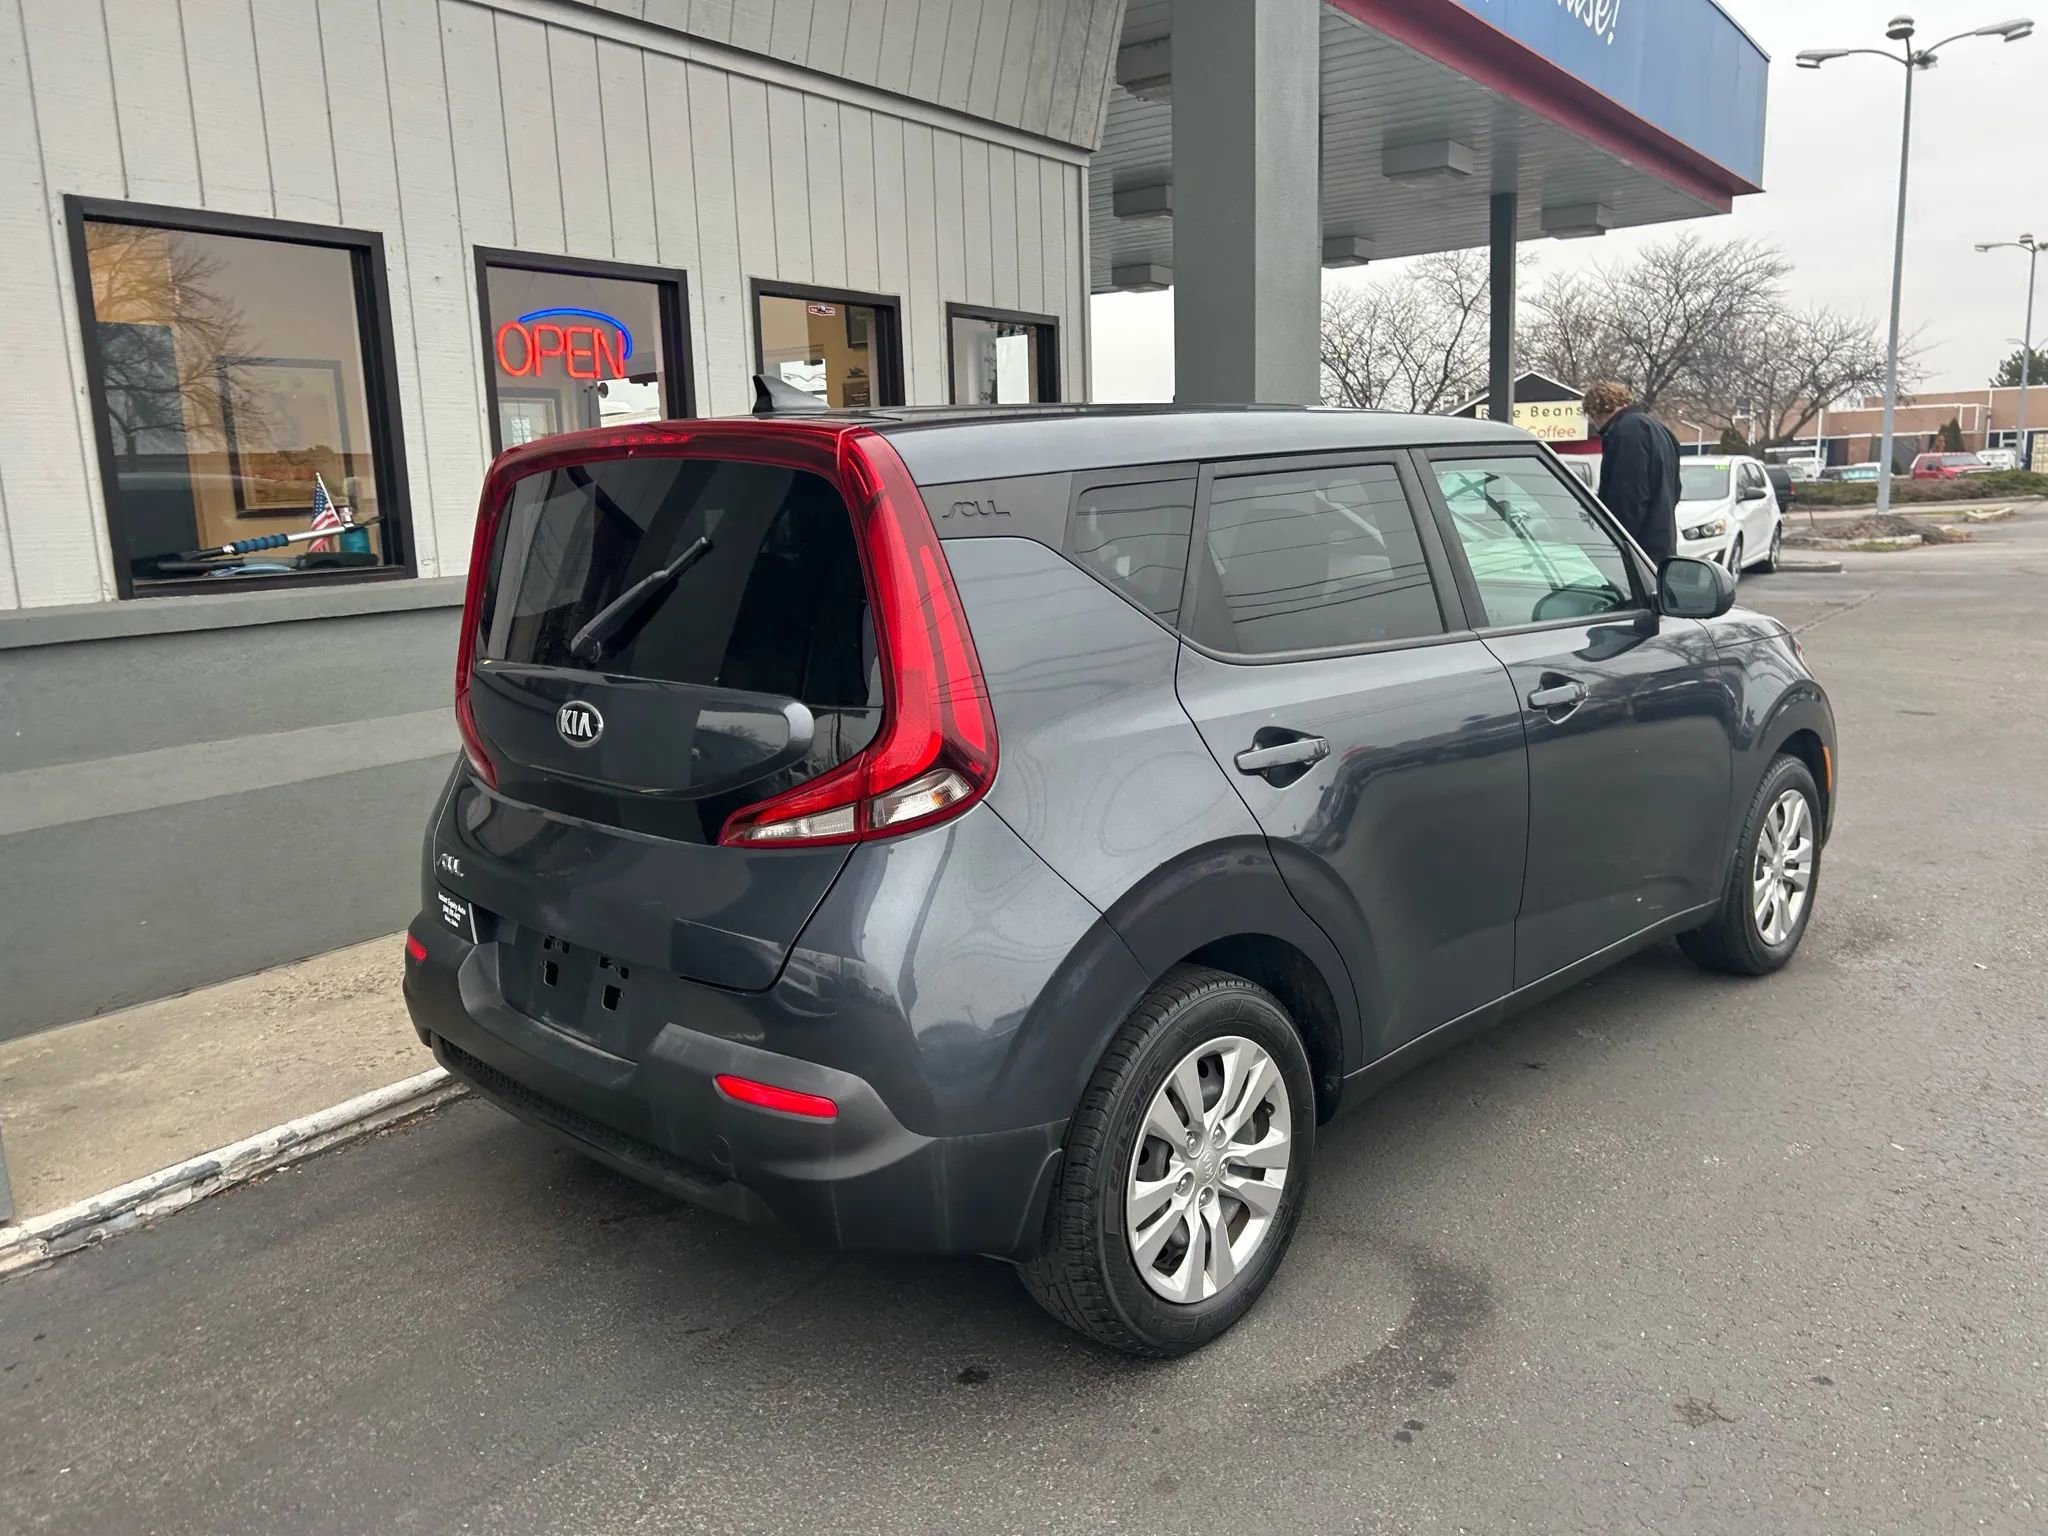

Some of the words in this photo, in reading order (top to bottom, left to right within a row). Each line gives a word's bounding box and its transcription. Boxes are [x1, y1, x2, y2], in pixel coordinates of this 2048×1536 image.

[496, 321, 625, 379] OPEN
[1530, 405, 1583, 417] Beans
[942, 500, 1011, 518] SOUL
[560, 709, 593, 737] KIA
